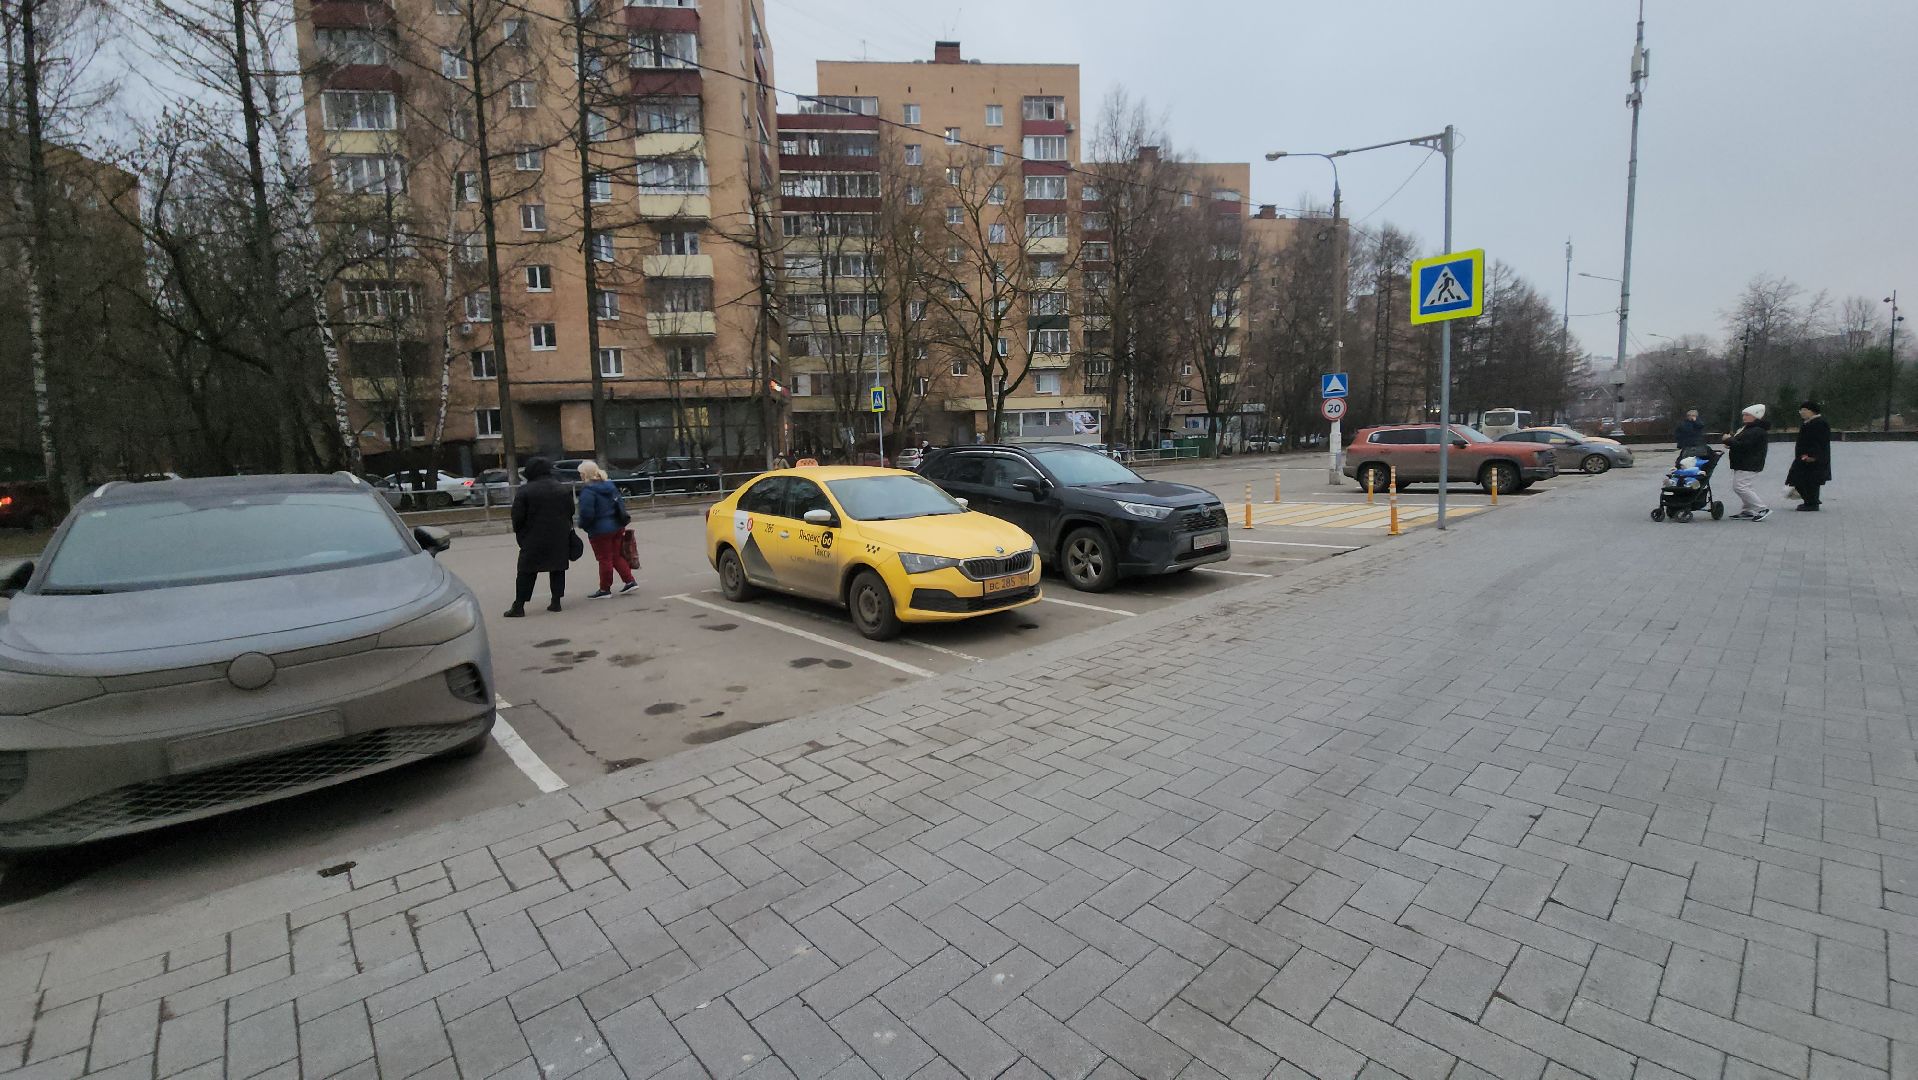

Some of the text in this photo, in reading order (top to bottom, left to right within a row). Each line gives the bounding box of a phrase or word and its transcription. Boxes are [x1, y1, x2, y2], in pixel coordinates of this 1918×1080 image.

[1328, 404, 1341, 413] 20
[799, 529, 820, 543] Яндекс
[814, 545, 831, 558] Такси
